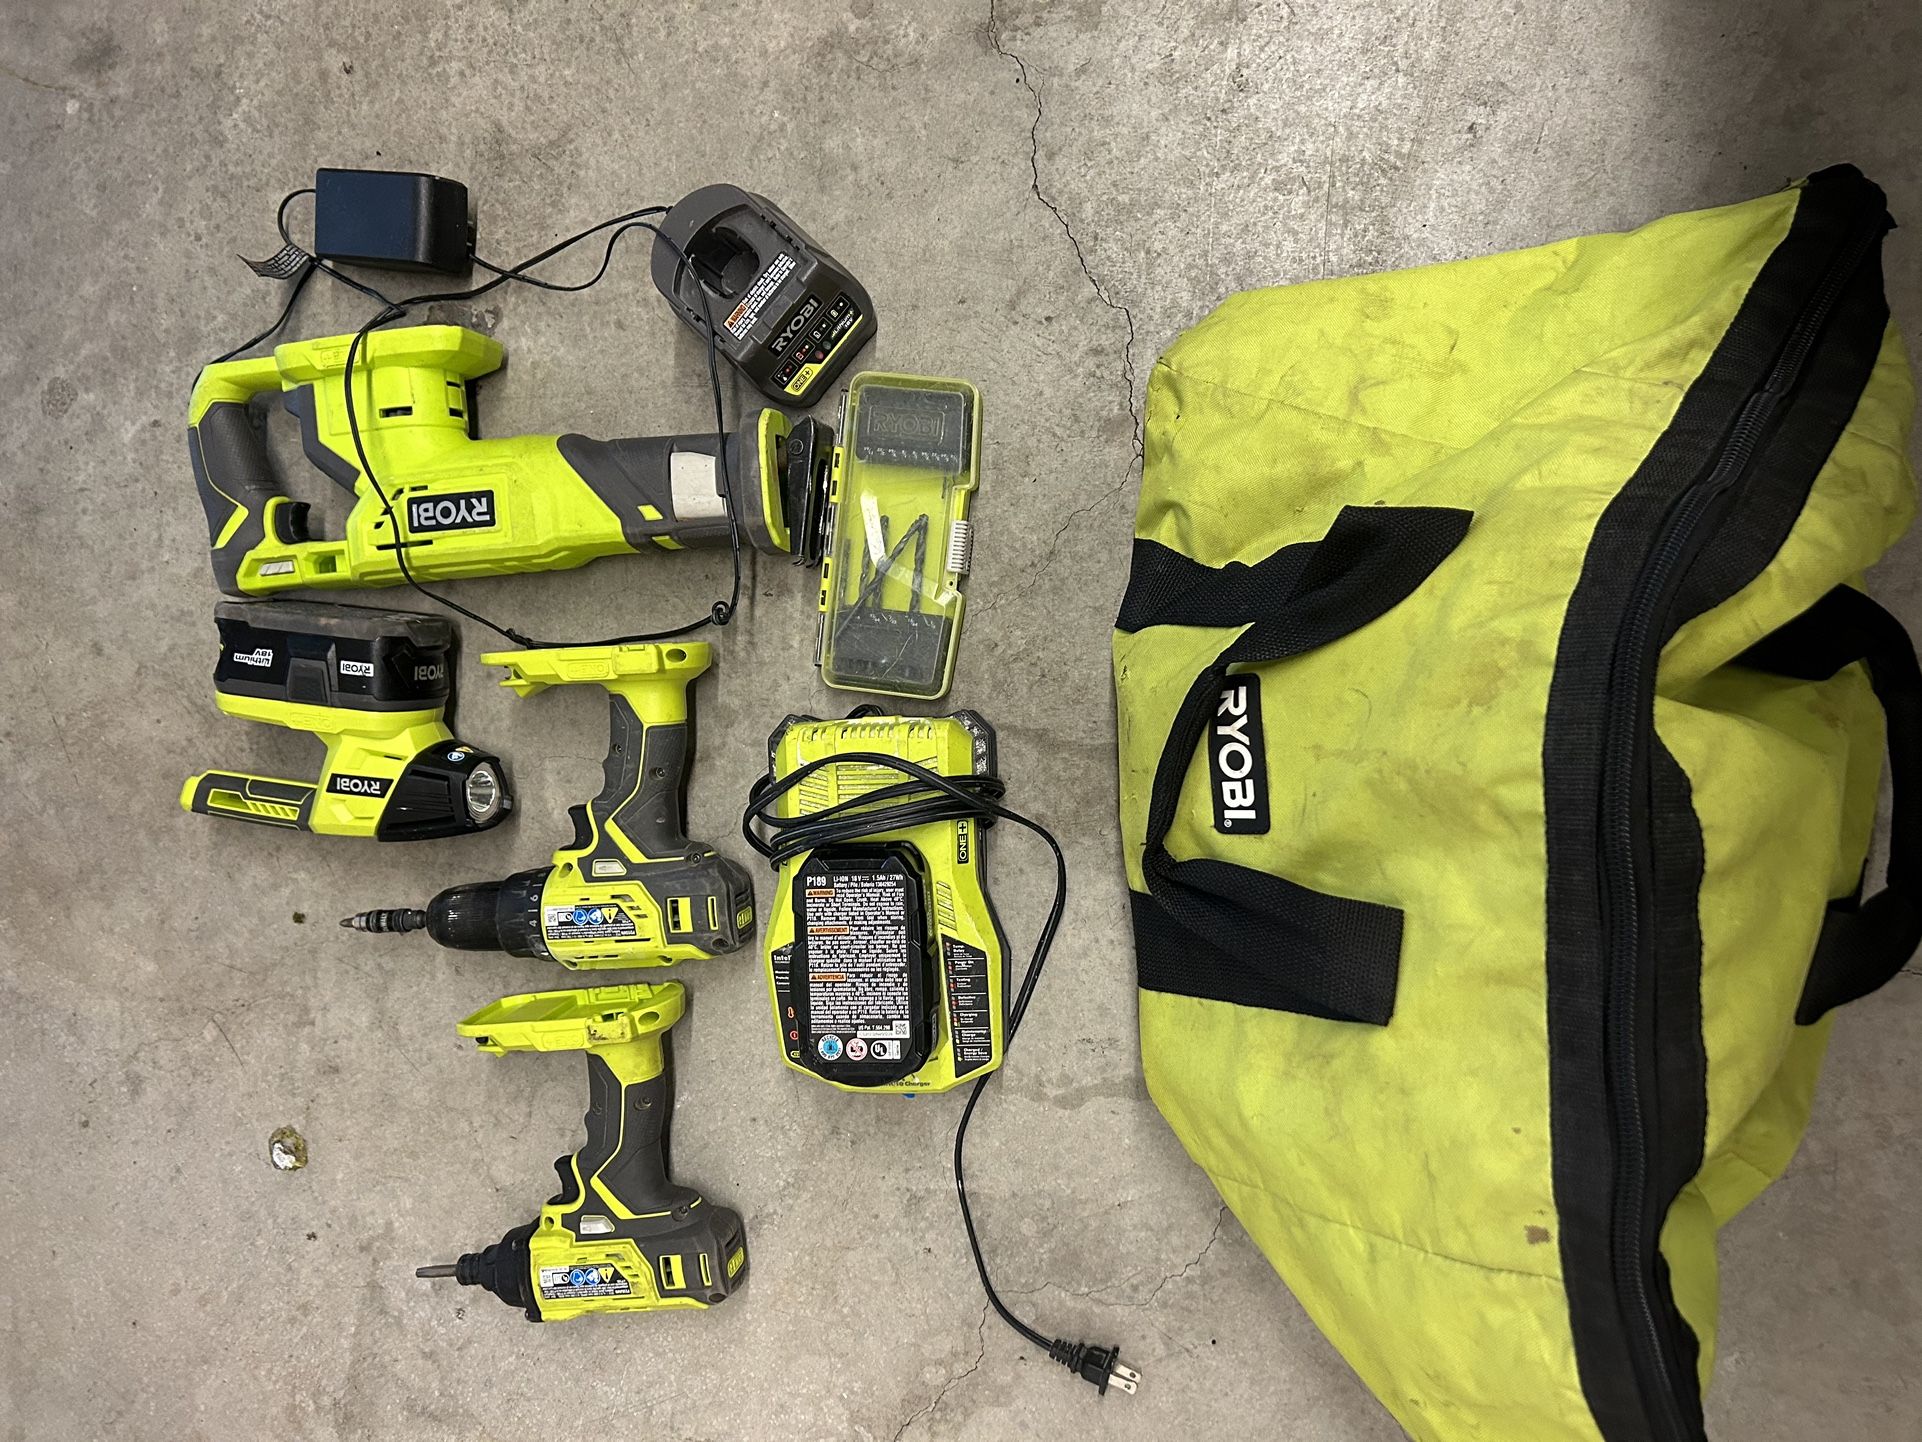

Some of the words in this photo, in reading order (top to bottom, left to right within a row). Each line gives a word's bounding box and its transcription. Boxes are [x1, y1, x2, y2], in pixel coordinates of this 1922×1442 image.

[772, 298, 819, 352] RYOBI
[873, 412, 940, 436] RYOBI
[412, 497, 490, 527] RYOBI
[235, 654, 270, 667] Lithium
[342, 663, 371, 674] RYOBI
[1216, 686, 1256, 819] RYOBI
[336, 777, 381, 795] RYOBI
[958, 822, 968, 860] ONE+
[806, 876, 827, 887] P189
[874, 1044, 886, 1055] UL
